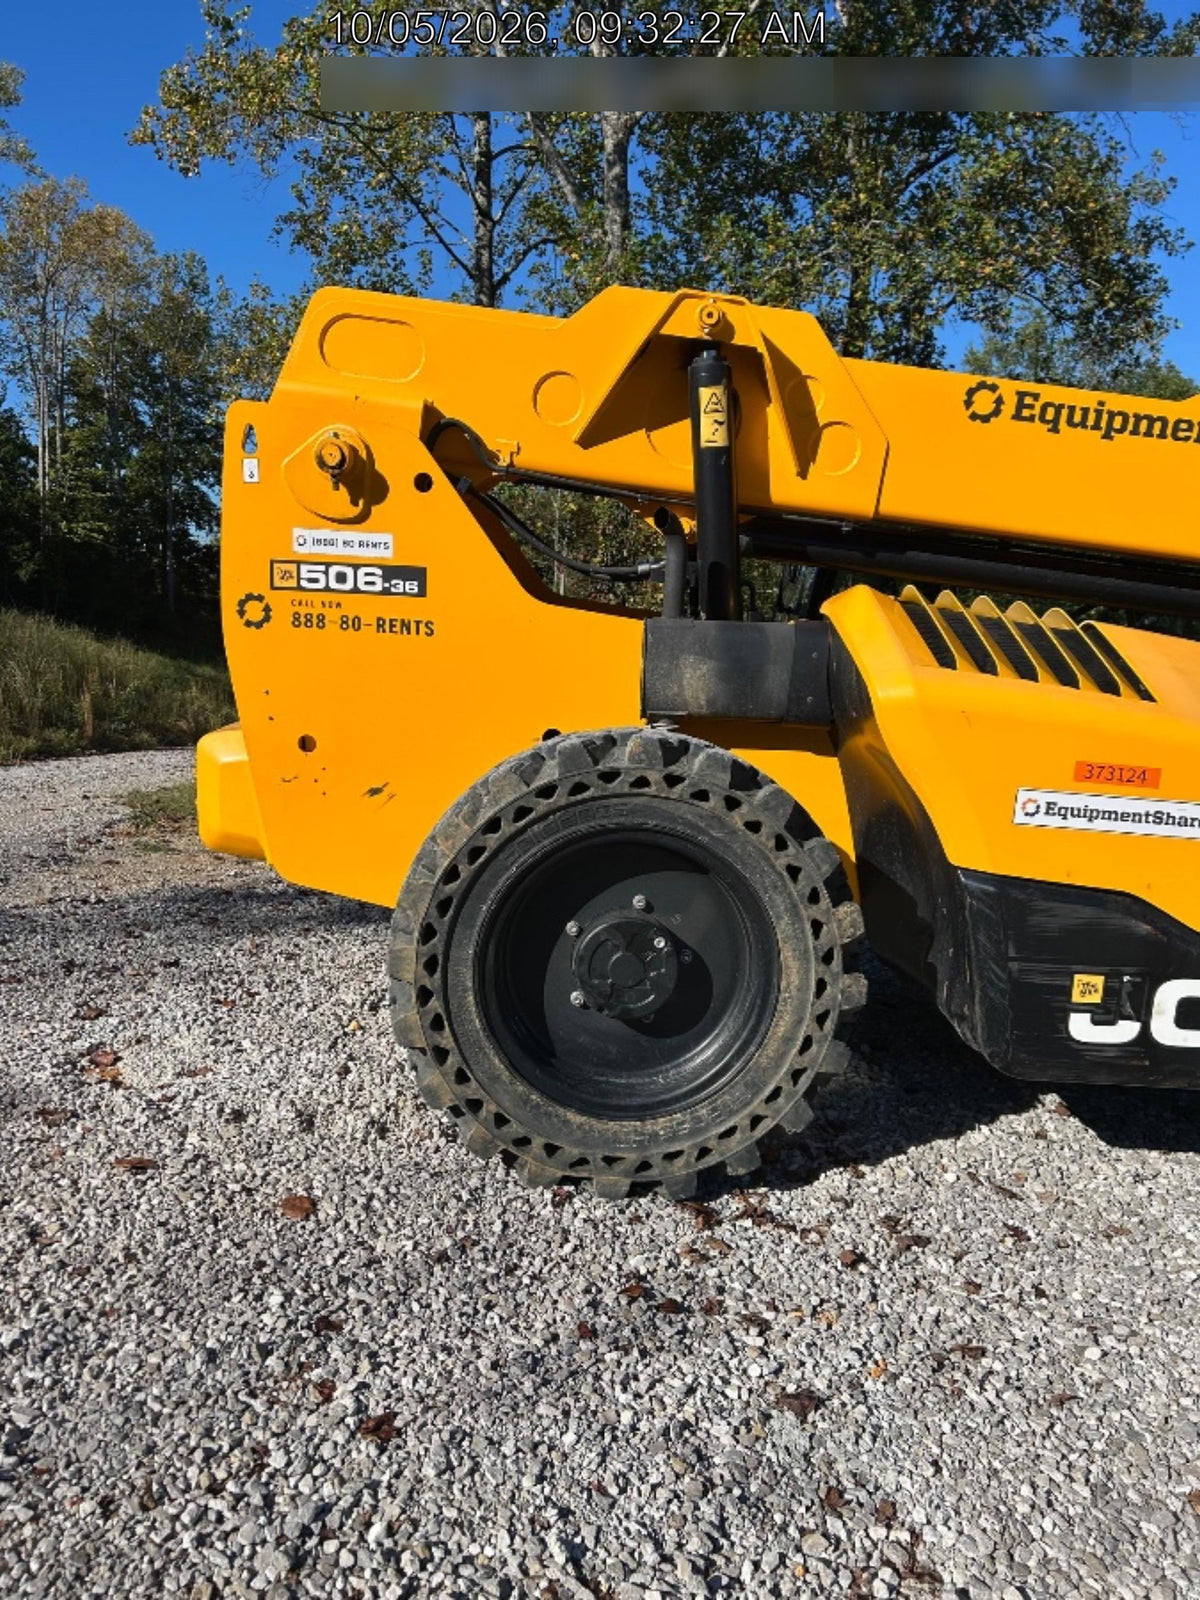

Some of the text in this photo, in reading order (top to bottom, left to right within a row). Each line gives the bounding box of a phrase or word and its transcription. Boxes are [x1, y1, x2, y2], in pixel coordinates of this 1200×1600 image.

[1011, 389, 1200, 444] Equipme
[299, 563, 419, 593] 506-36
[290, 598, 316, 609] CALL
[1083, 763, 1149, 785] 373124
[1043, 800, 1200, 829] EquipmentShar
